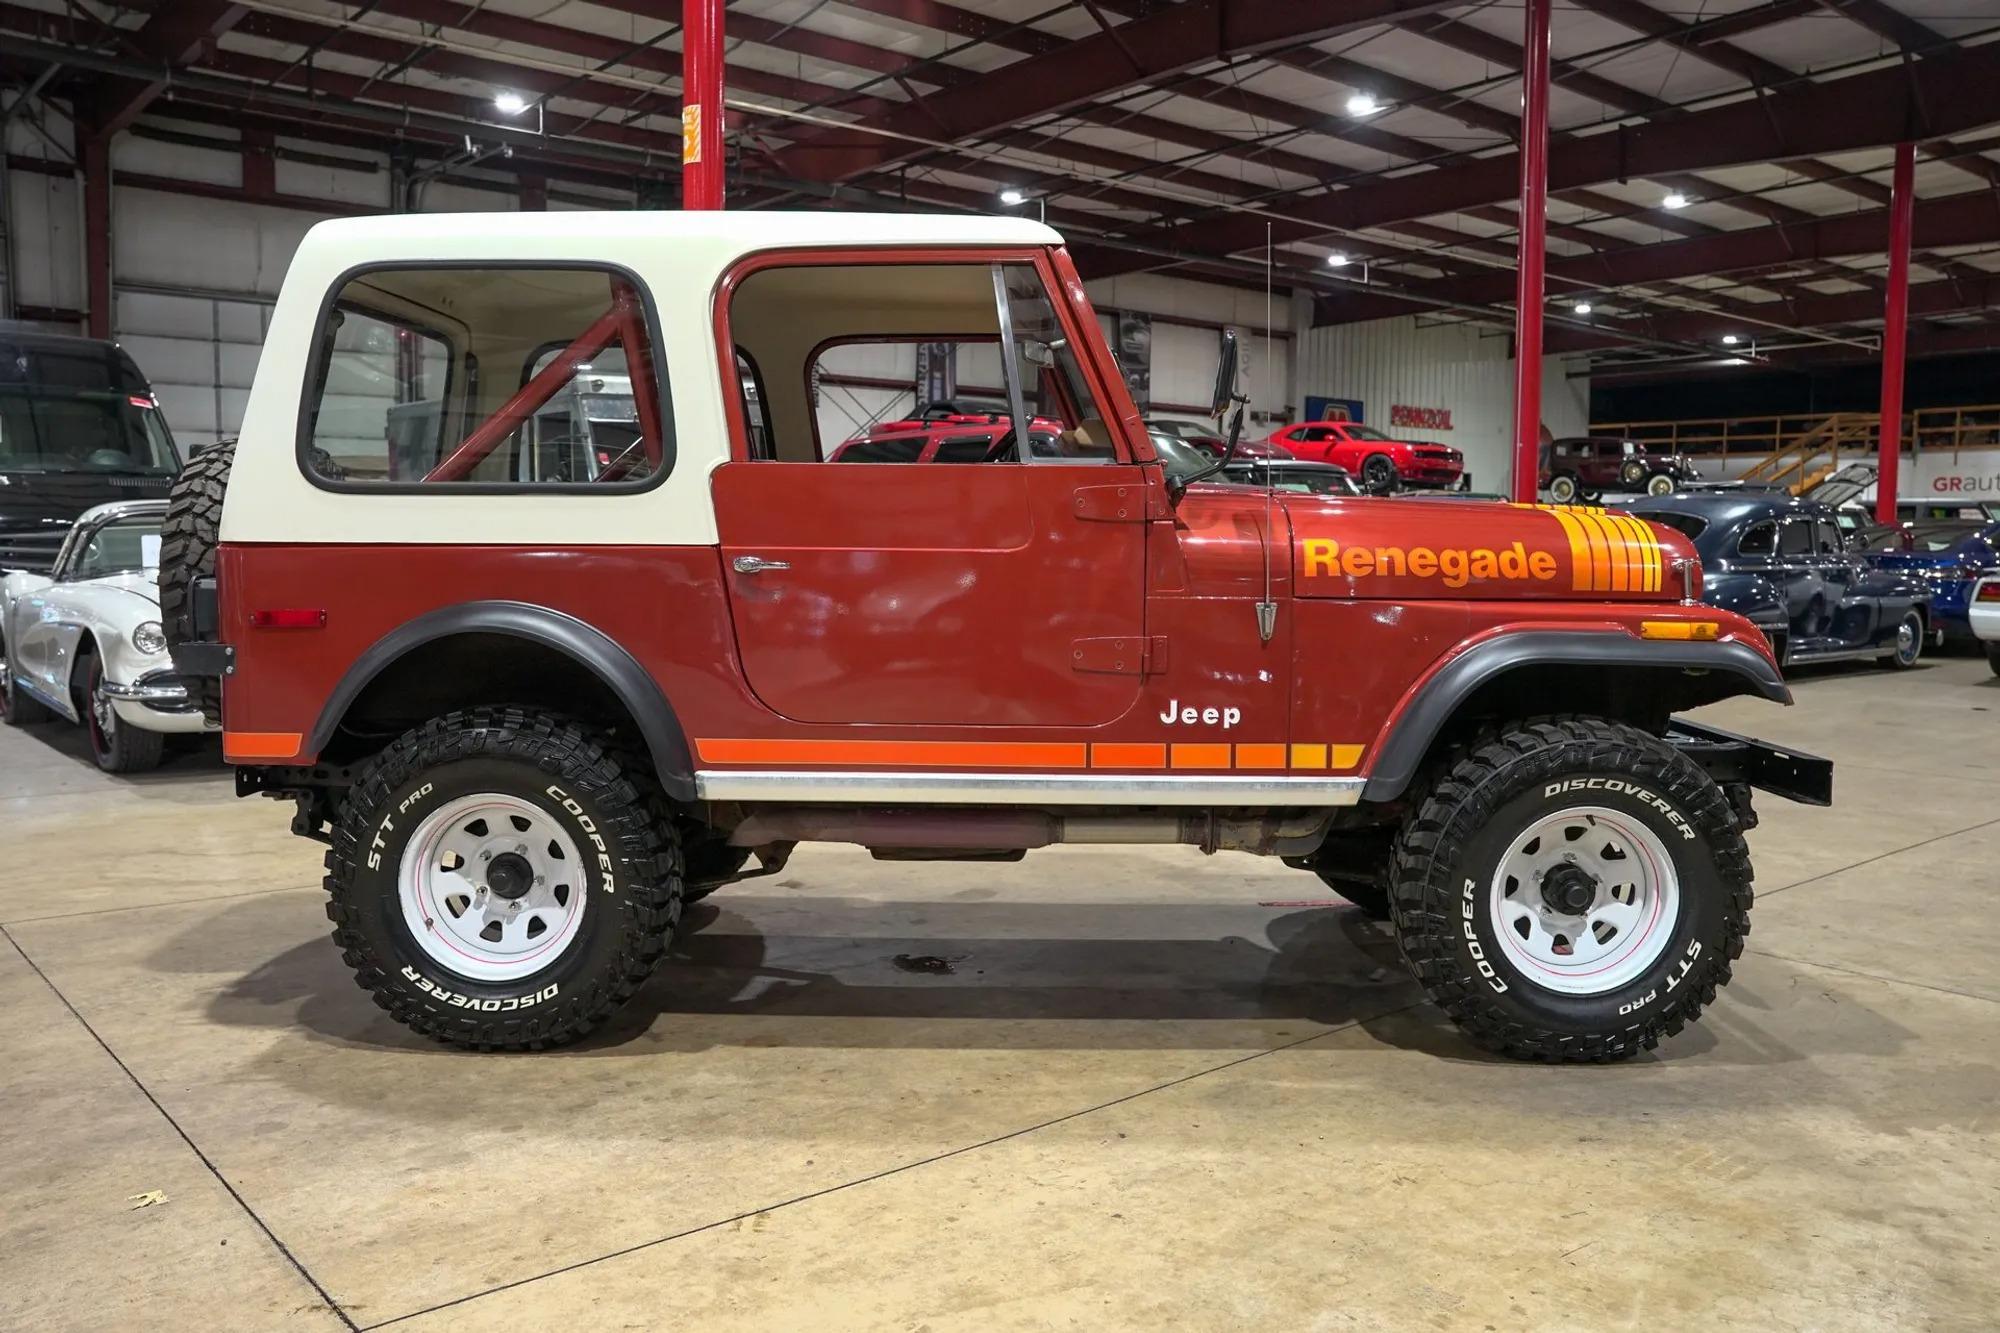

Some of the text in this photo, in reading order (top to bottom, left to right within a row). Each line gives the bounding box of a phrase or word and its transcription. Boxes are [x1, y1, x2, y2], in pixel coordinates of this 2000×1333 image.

[1302, 538, 1557, 588] Renegade
[1160, 699, 1241, 729] Jeep
[367, 782, 433, 871] STT PRO
[546, 785, 615, 894] COOPER
[1544, 778, 1696, 840] DISCOVERER
[1462, 878, 1509, 994] COOPER
[401, 964, 559, 1012] DISCOVERER
[1618, 938, 1702, 1016] STT PRO
